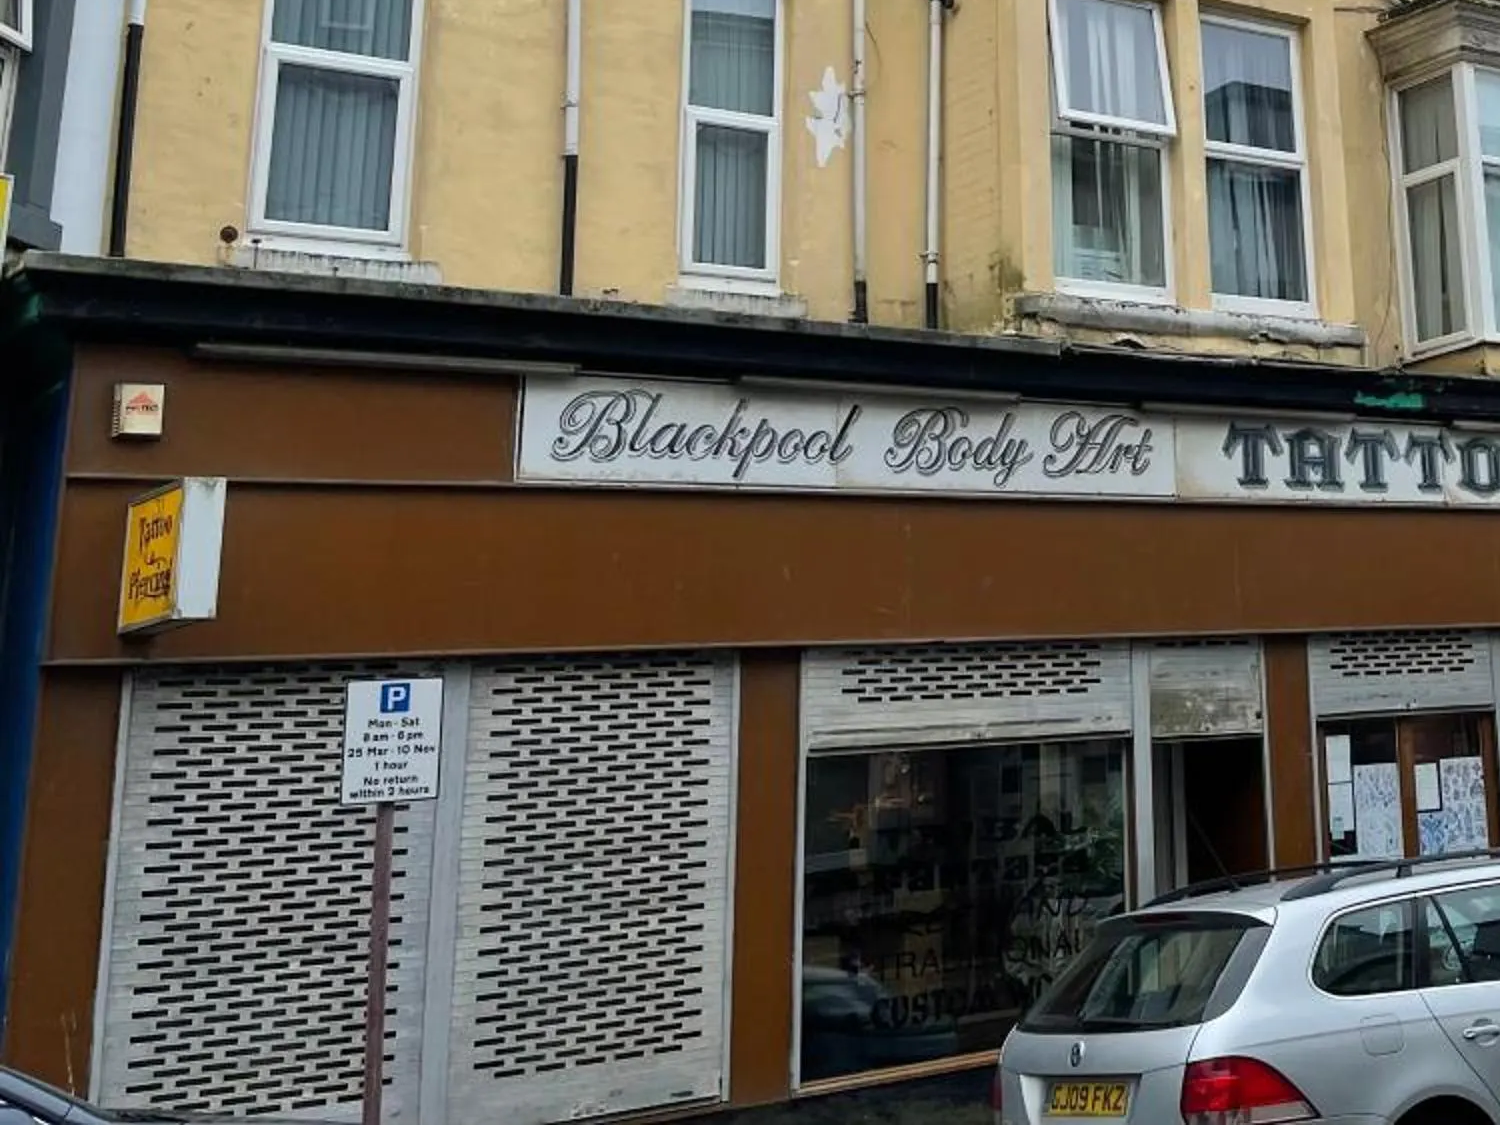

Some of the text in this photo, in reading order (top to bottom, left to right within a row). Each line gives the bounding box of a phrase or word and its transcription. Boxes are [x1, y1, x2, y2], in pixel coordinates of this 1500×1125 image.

[551, 388, 1154, 487] Blackpool Body Art
[387, 686, 406, 711] P
[367, 718, 393, 729] Mon
[401, 717, 420, 728] Sat
[367, 746, 389, 757] Mar
[383, 761, 409, 771] hour
[363, 774, 419, 786] No return
[349, 787, 385, 800] within
[398, 785, 430, 797] hours
[1092, 1085, 1126, 1112] FKZ
